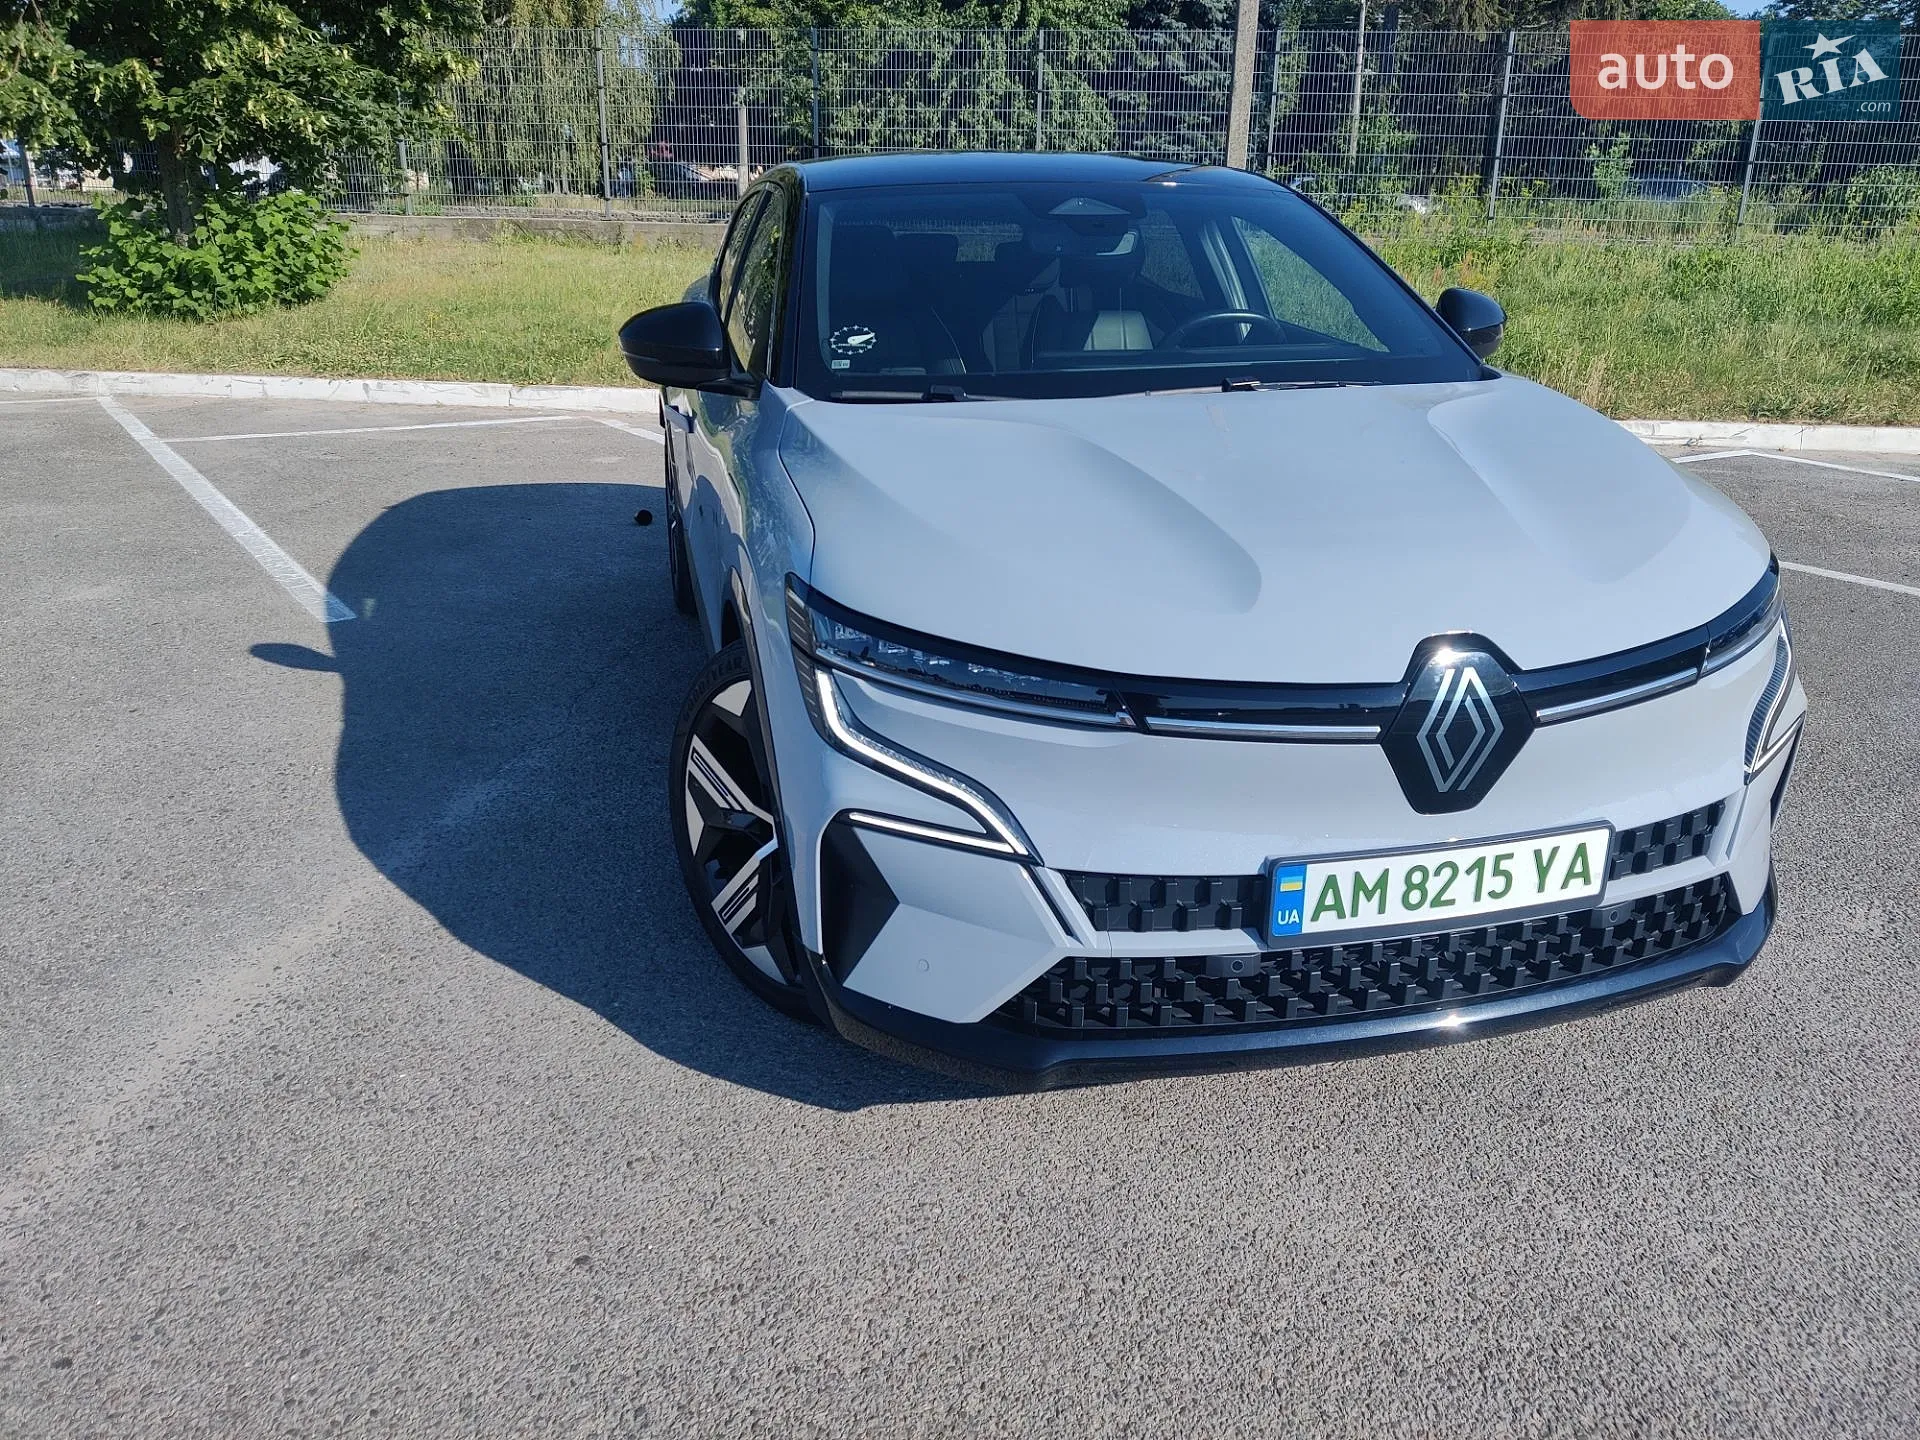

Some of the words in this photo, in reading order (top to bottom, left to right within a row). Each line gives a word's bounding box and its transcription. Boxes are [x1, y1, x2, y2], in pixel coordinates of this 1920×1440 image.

[1310, 868, 1390, 922] AM
[1401, 853, 1515, 911] 8215
[1533, 842, 1593, 894] YA
[1277, 910, 1300, 926] UA
